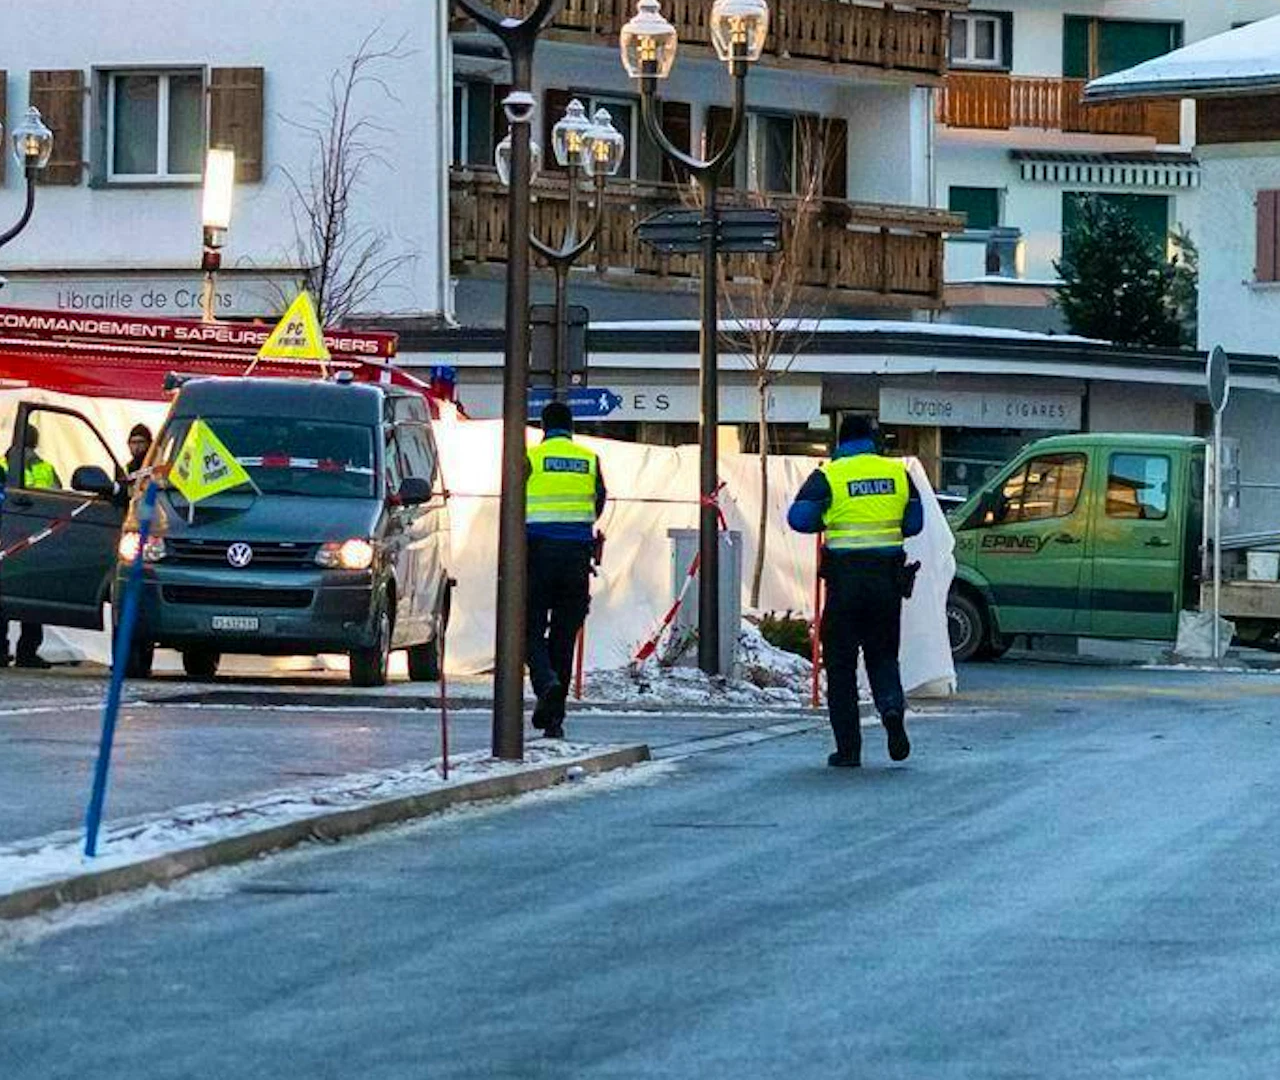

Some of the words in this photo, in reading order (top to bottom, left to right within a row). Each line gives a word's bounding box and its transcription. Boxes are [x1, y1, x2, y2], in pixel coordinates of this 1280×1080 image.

[140, 290, 166, 308] de
[286, 322, 304, 336] PC
[1005, 403, 1066, 418] CIGARES
[203, 452, 220, 469] PC
[545, 457, 589, 472] POLICE
[849, 478, 895, 495] POLICE
